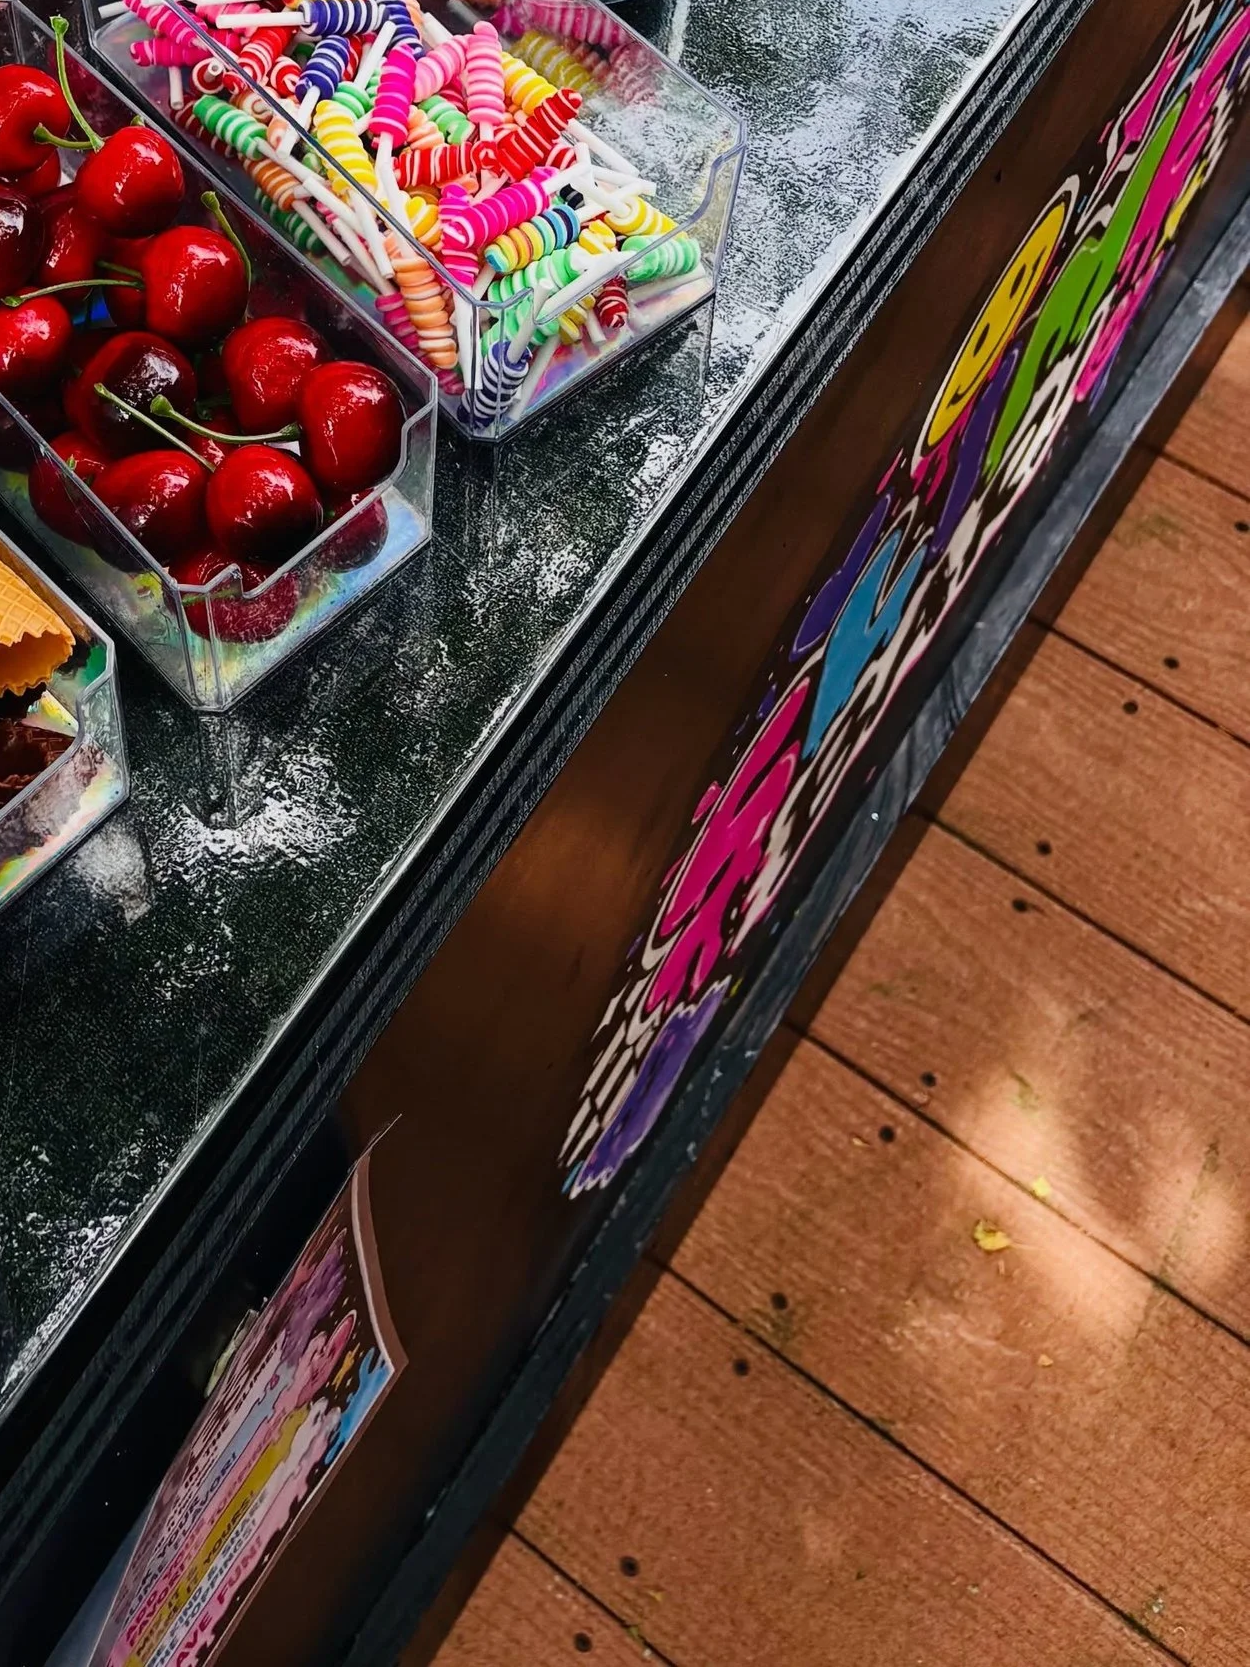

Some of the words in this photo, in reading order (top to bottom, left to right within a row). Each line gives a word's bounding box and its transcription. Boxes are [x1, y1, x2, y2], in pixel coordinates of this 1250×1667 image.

[647, 0, 1250, 1014] SLIME
[157, 1495, 201, 1560] YOUR
[171, 1450, 237, 1551] FLAVOR!
[202, 1488, 256, 1567] YOURS!
[122, 1587, 160, 1642] ADD
[161, 1517, 206, 1582] YOUR
[127, 1531, 206, 1648] FAVORITE
[134, 1613, 165, 1657] MIX
[165, 1586, 183, 1609] IT
[168, 1585, 204, 1637] KIND
[171, 1611, 214, 1667] AVE
[214, 1534, 265, 1605] FUN!
[183, 1517, 258, 1628] TOPPINGS!
